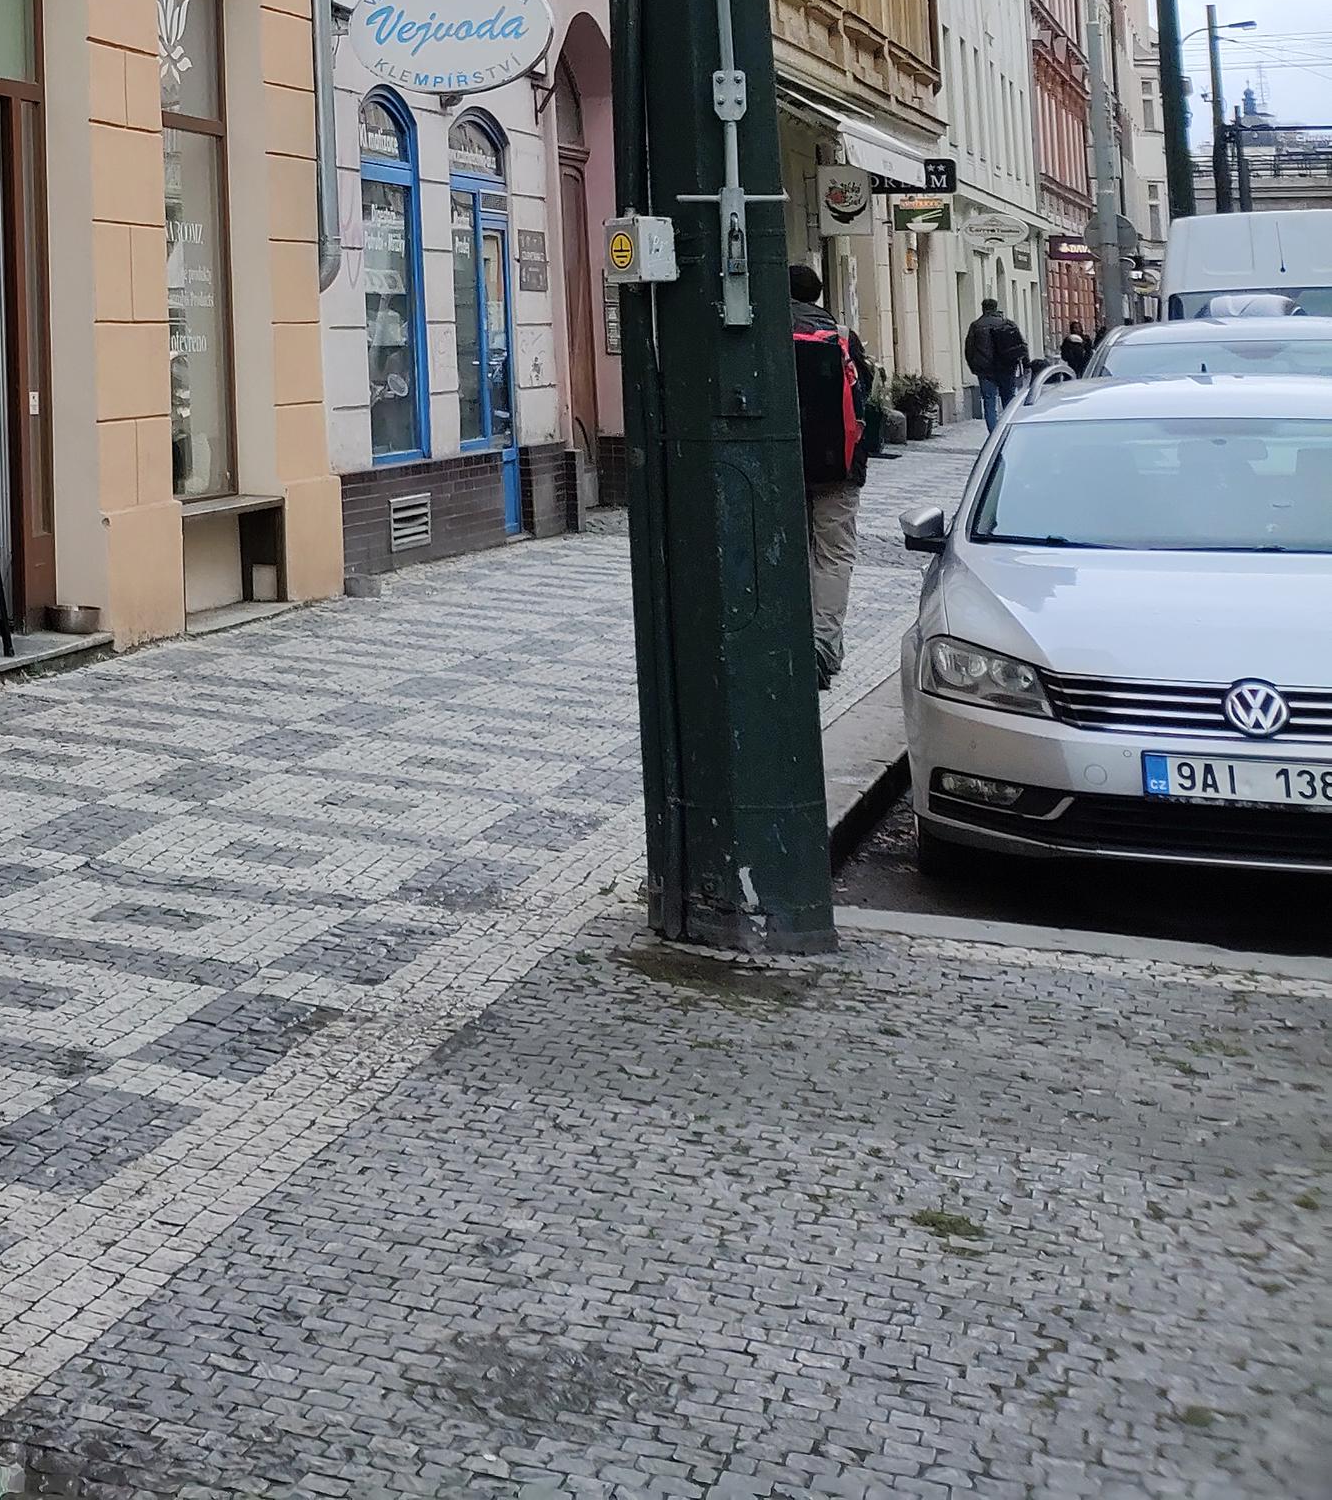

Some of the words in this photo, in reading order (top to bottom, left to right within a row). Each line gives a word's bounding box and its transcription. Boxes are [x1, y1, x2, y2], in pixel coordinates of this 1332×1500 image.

[365, 5, 528, 57] Vejvoda
[374, 53, 522, 87] KLEMPÍŘSTVÍ
[171, 326, 207, 352] otevřeno
[1228, 686, 1284, 733] VW
[1150, 778, 1167, 790] CZ
